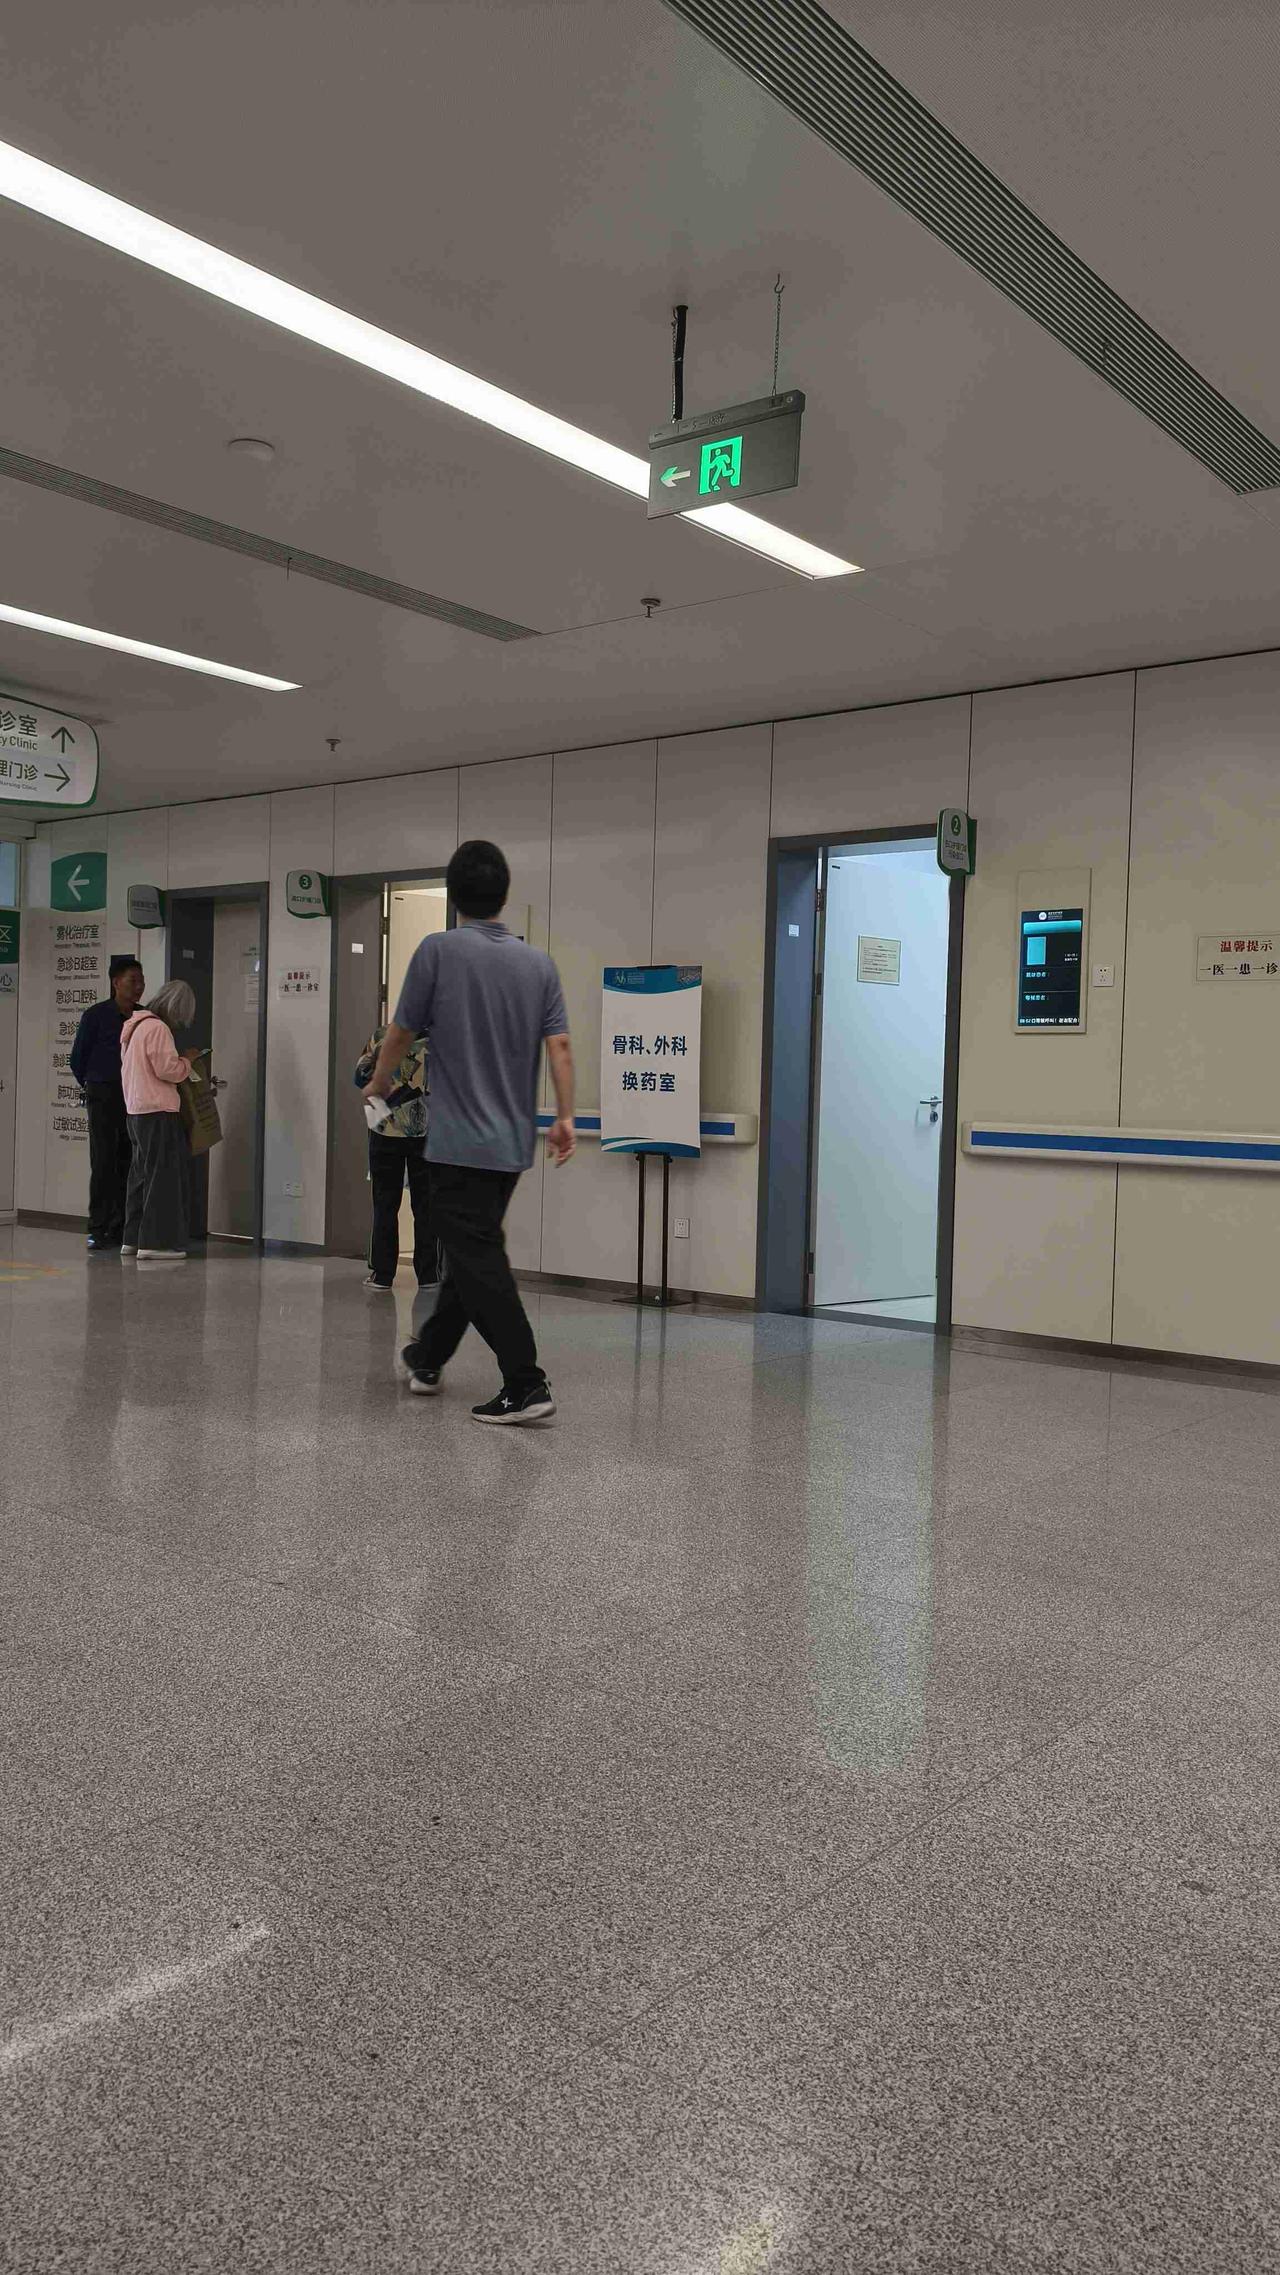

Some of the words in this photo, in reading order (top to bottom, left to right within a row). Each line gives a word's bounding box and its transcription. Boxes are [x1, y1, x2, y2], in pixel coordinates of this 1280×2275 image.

[9, 735, 39, 751] Clinic
[1220, 940, 1273, 953] 温馨提示
[56, 957, 98, 972] 急诊B超室
[1199, 962, 1280, 976] 一医一患一诊
[55, 989, 98, 1004] 急诊口腔科
[612, 1034, 688, 1056] 骨科、外科
[622, 1070, 676, 1092] 换药室
